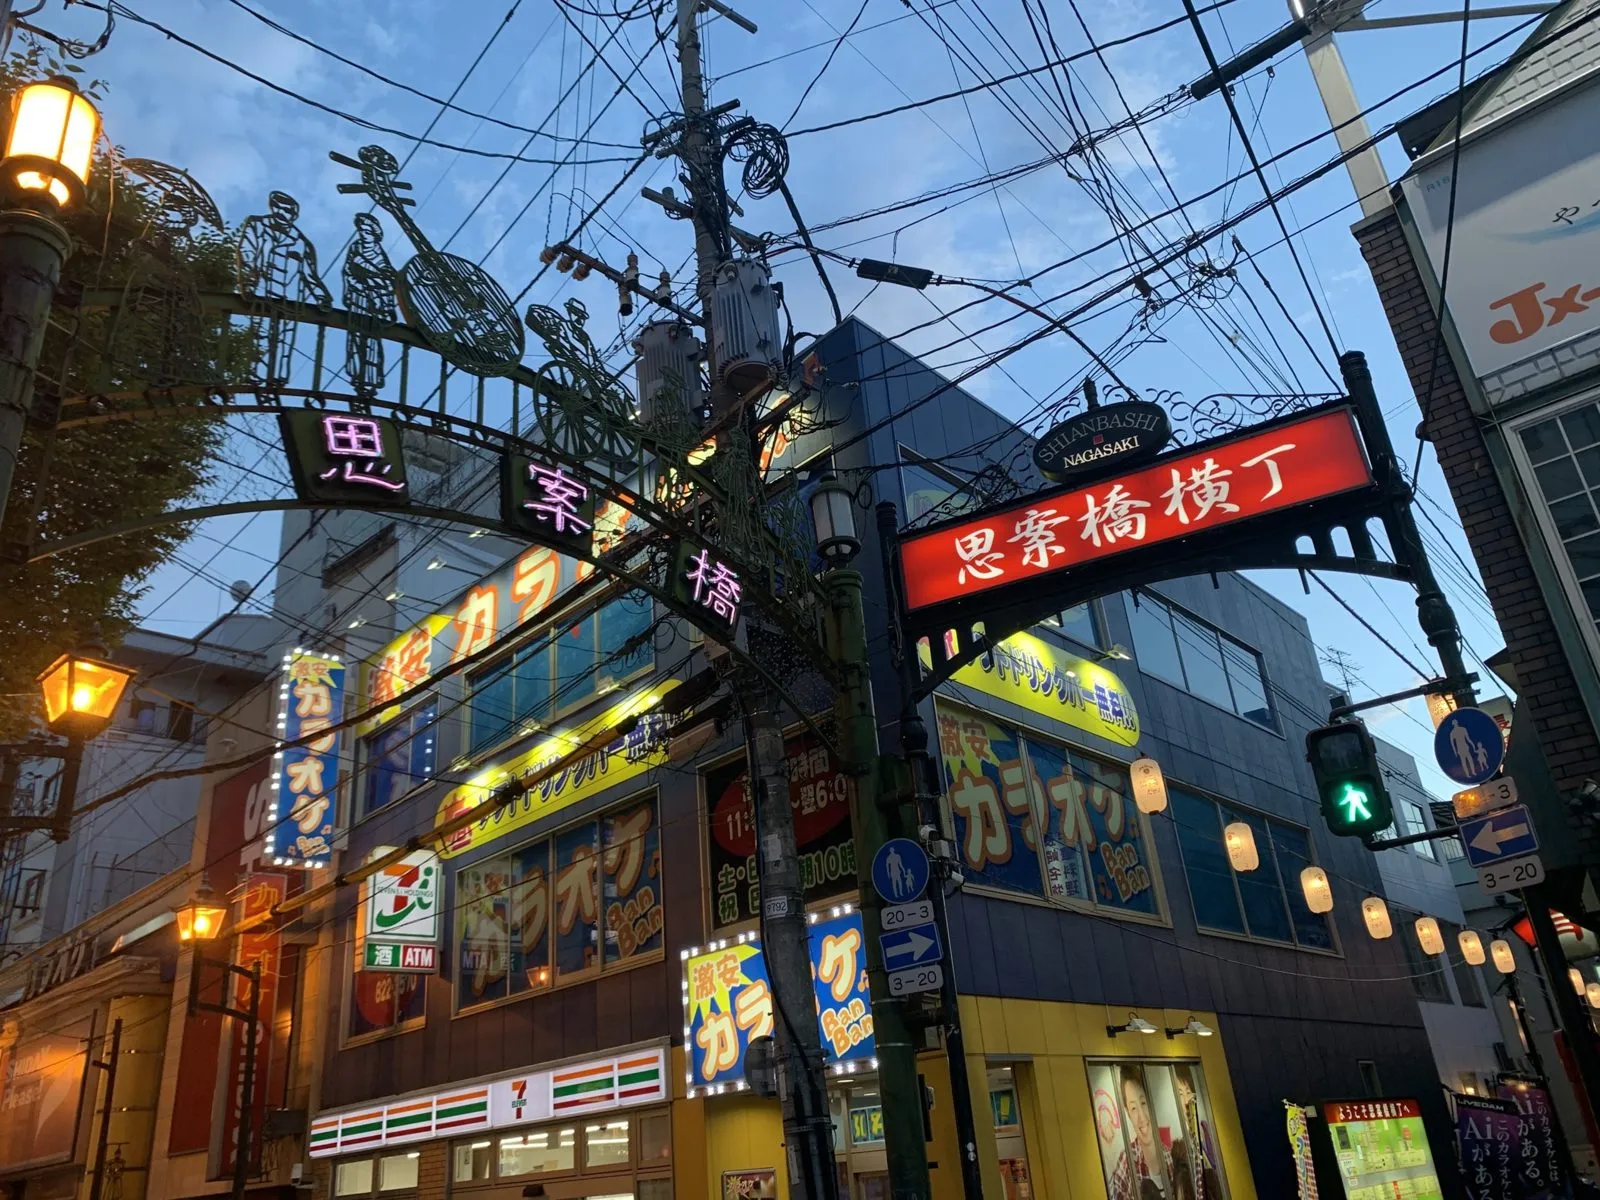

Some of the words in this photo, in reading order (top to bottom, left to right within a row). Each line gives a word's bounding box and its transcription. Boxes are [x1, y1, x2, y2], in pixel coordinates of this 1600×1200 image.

[1039, 412, 1160, 463] SHIANBASHI
[1062, 435, 1141, 470] NAGASAKI
[953, 443, 1296, 585] 思案橋横丁
[287, 680, 335, 834] カラオケ
[950, 758, 1125, 872] カラオケ
[374, 945, 394, 966] 酒
[404, 948, 433, 967] ATM
[693, 952, 742, 1002] 激安
[821, 998, 866, 1042] Ban
[831, 1014, 874, 1057] Ban
[1456, 1098, 1505, 1112] LIVEDAM
